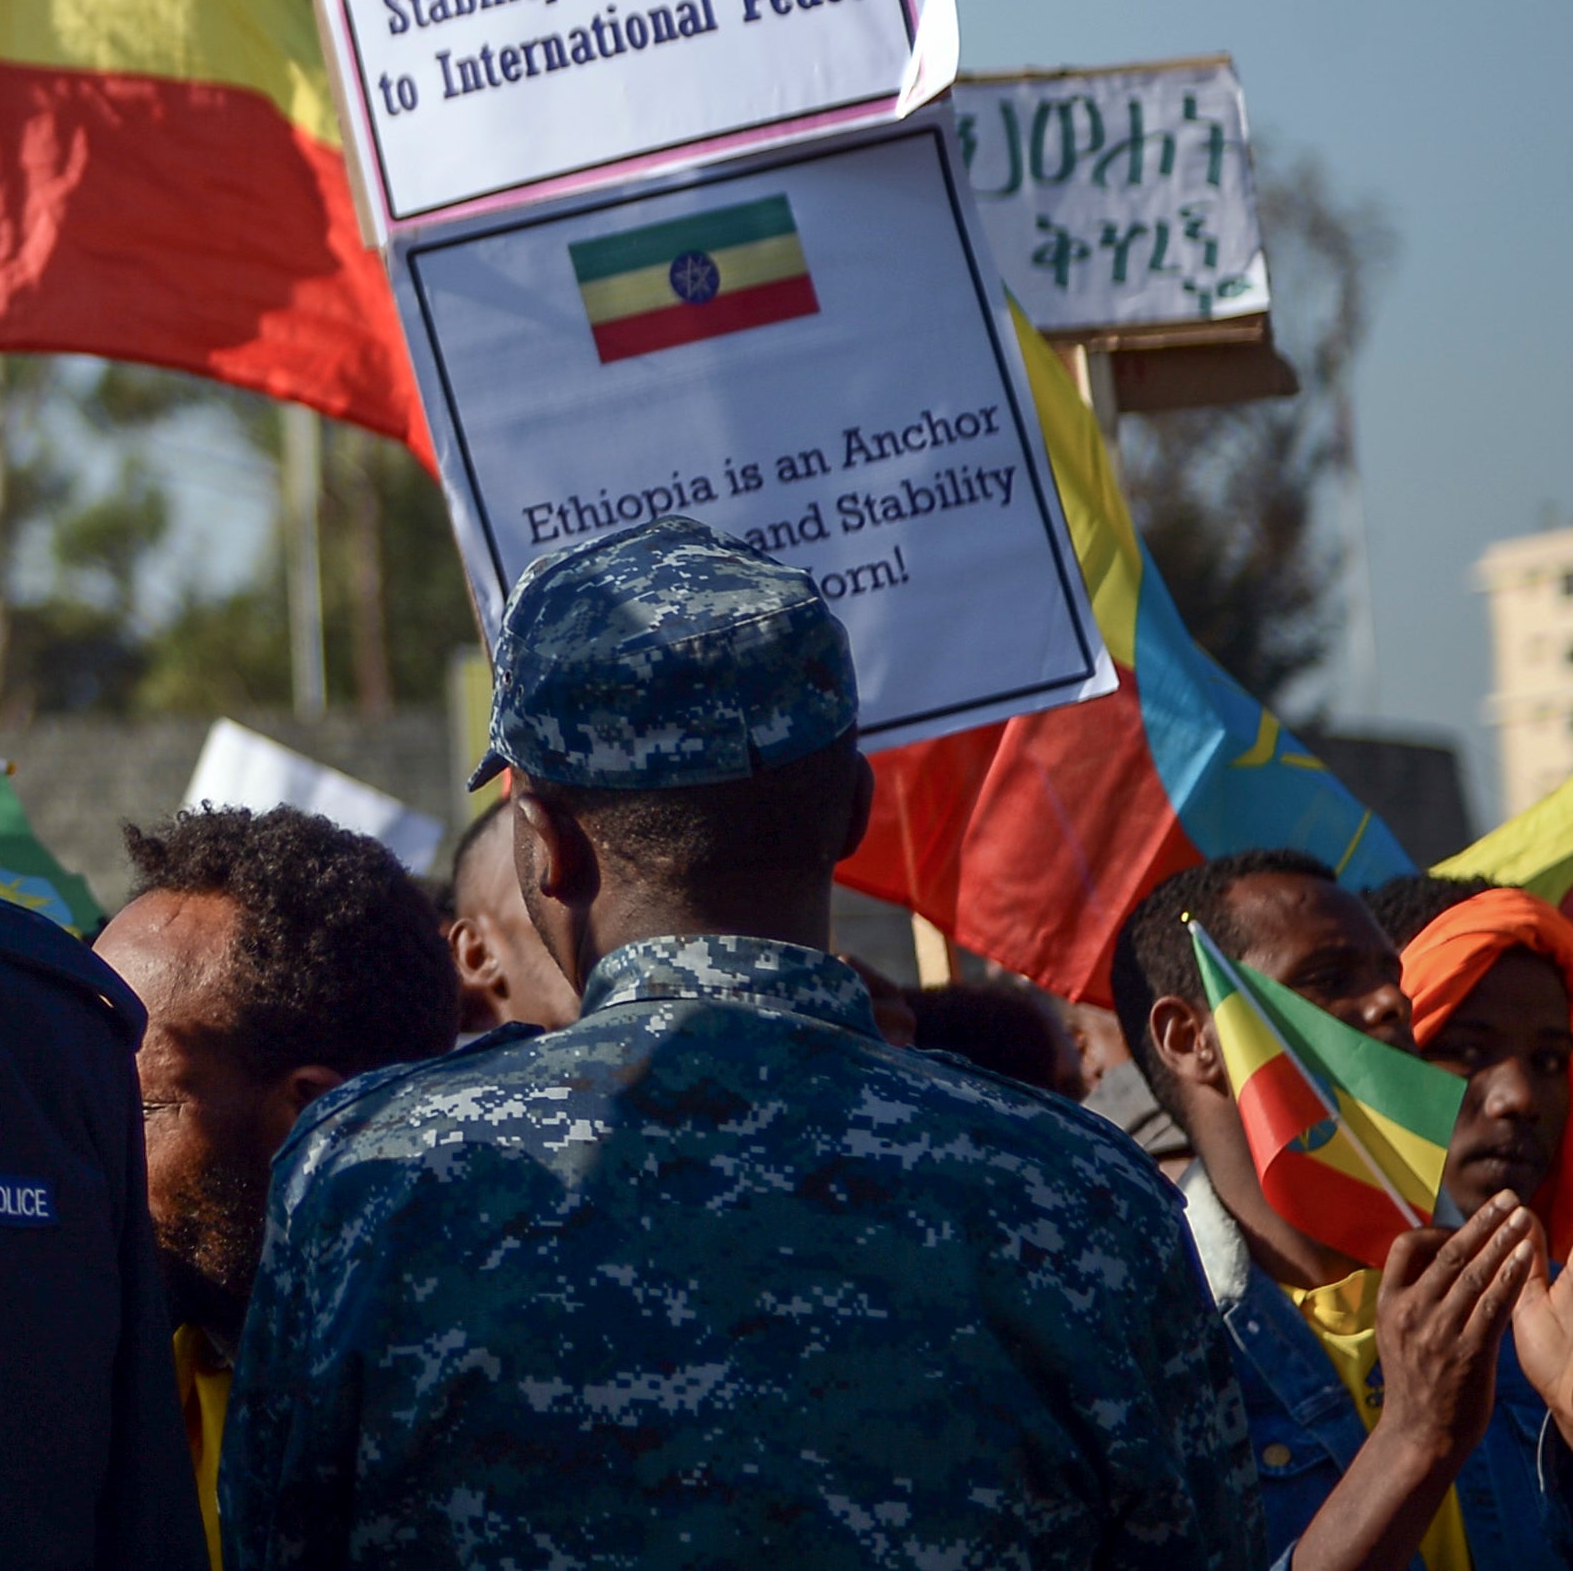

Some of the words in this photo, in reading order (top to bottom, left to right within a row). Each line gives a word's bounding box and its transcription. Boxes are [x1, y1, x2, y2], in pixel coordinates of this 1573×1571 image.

[378, 71, 419, 117] to
[522, 470, 718, 546] Ethiopia
[724, 458, 764, 496] is
[775, 445, 831, 484] an
[841, 405, 1000, 470] Anchor
[743, 502, 831, 553] and
[836, 465, 1017, 534] Stability
[808, 545, 910, 602] orn!
